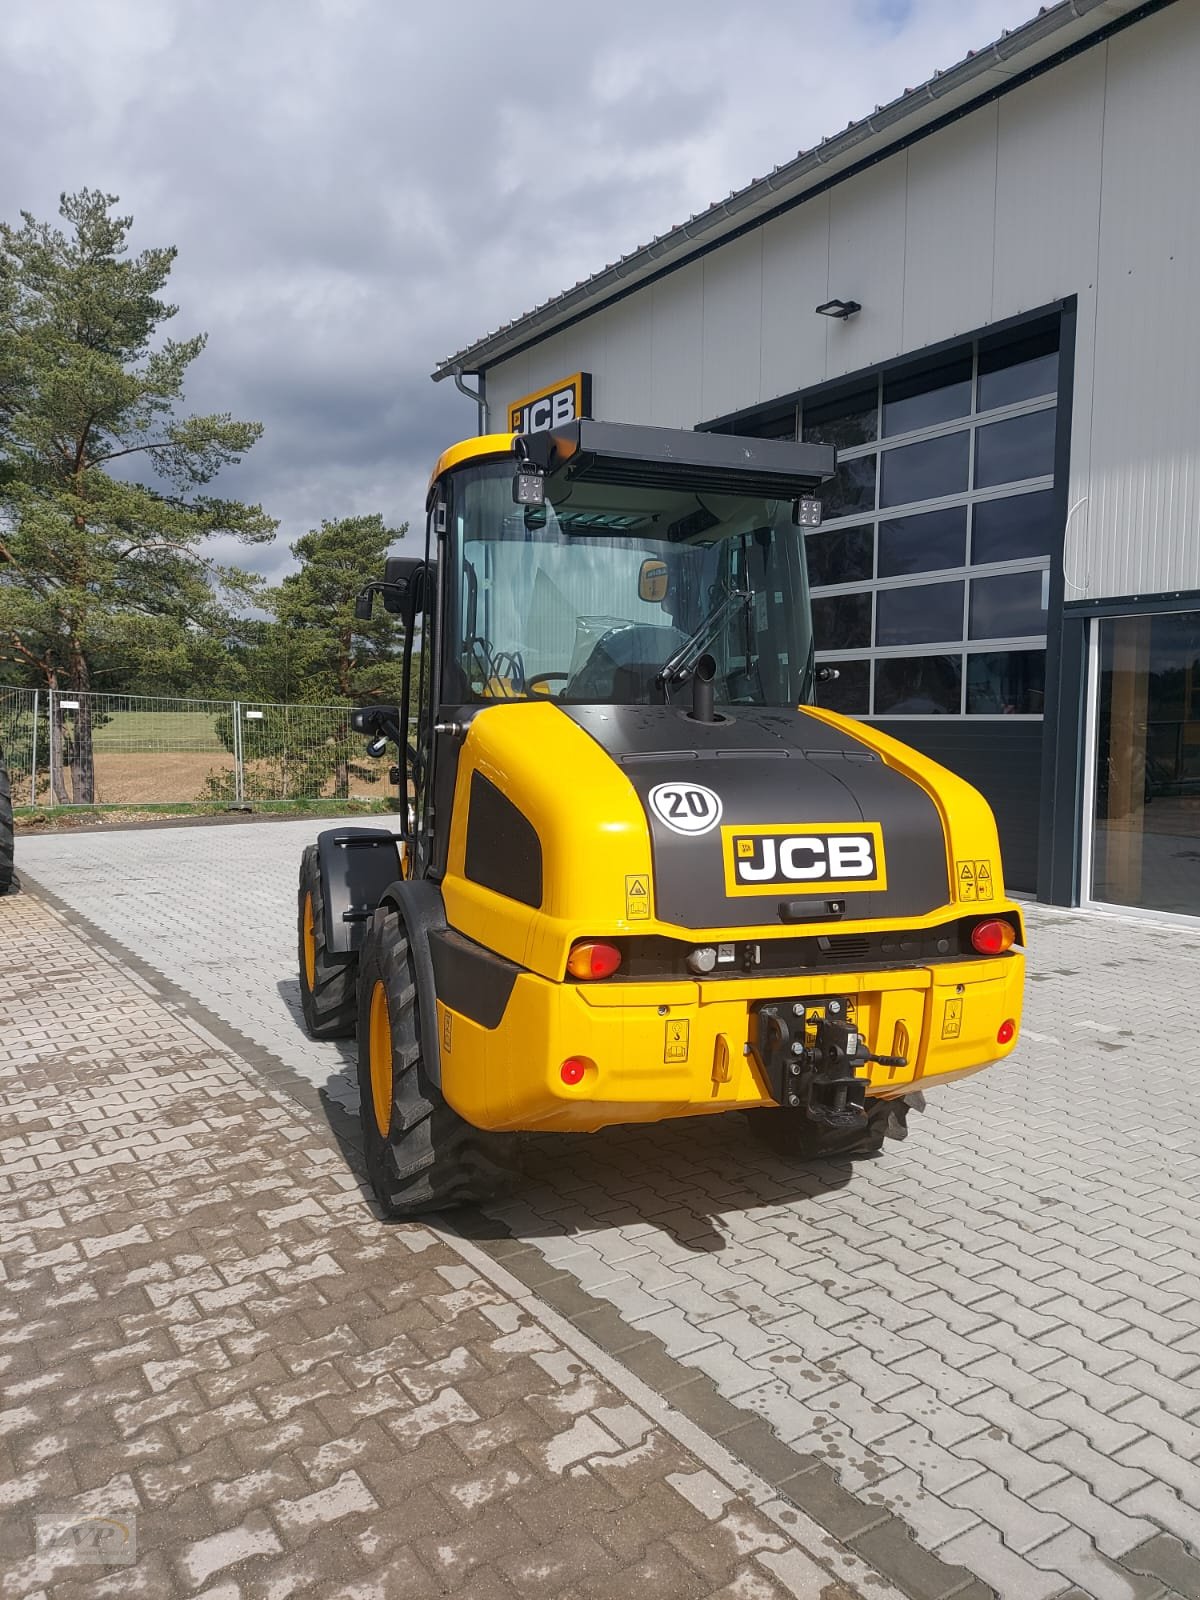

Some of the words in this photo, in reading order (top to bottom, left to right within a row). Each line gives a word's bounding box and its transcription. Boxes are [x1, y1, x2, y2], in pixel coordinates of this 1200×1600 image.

[513, 389, 574, 434] JCB
[663, 791, 709, 818] 20
[738, 836, 874, 881] JCB
